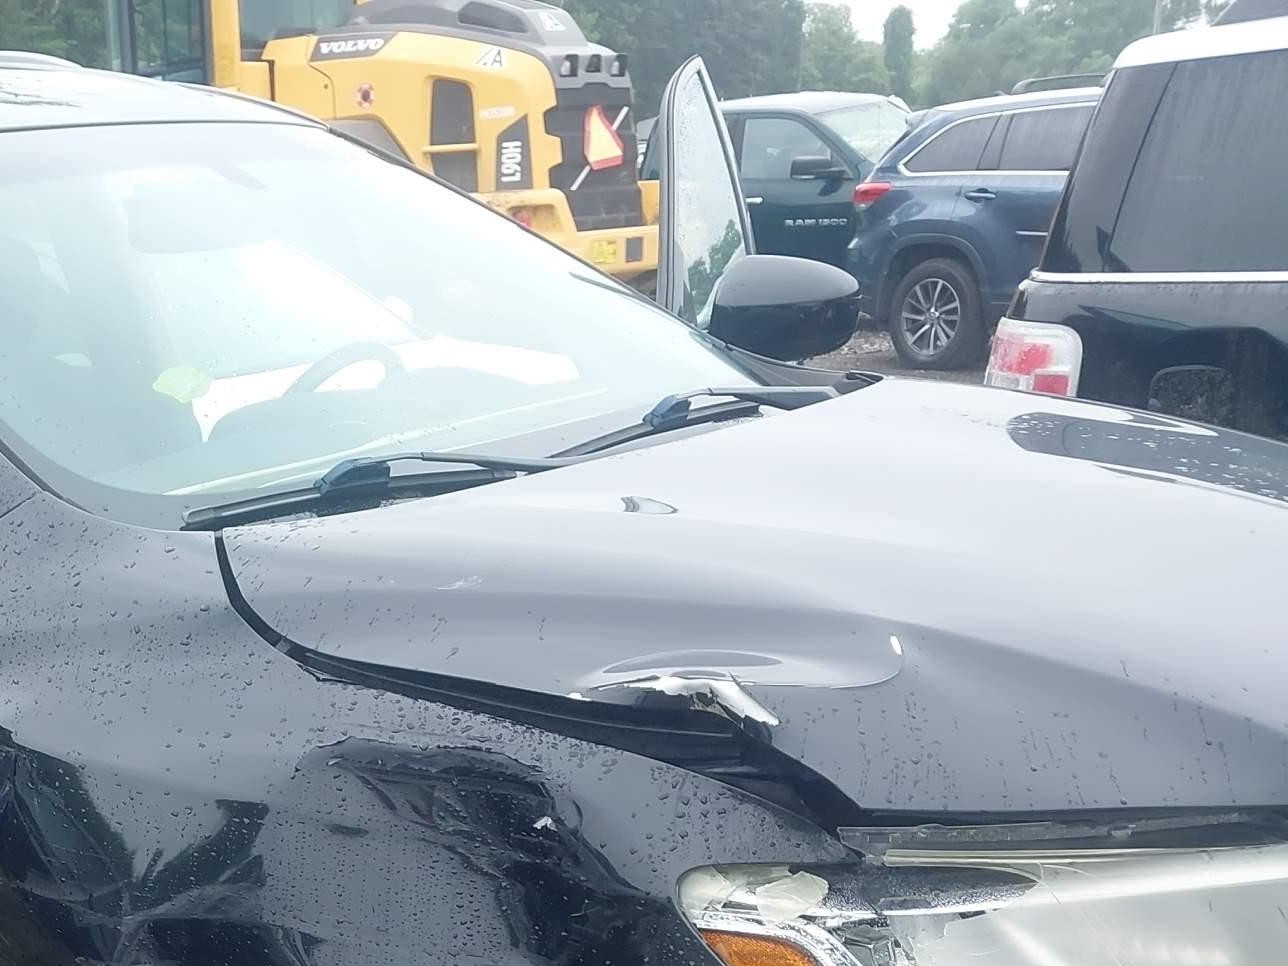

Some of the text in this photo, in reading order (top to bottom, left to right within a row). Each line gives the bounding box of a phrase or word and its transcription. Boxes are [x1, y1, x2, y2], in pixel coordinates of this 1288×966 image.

[319, 38, 385, 54] VOLVO
[501, 141, 522, 182] L90H
[785, 218, 817, 227] RAM
